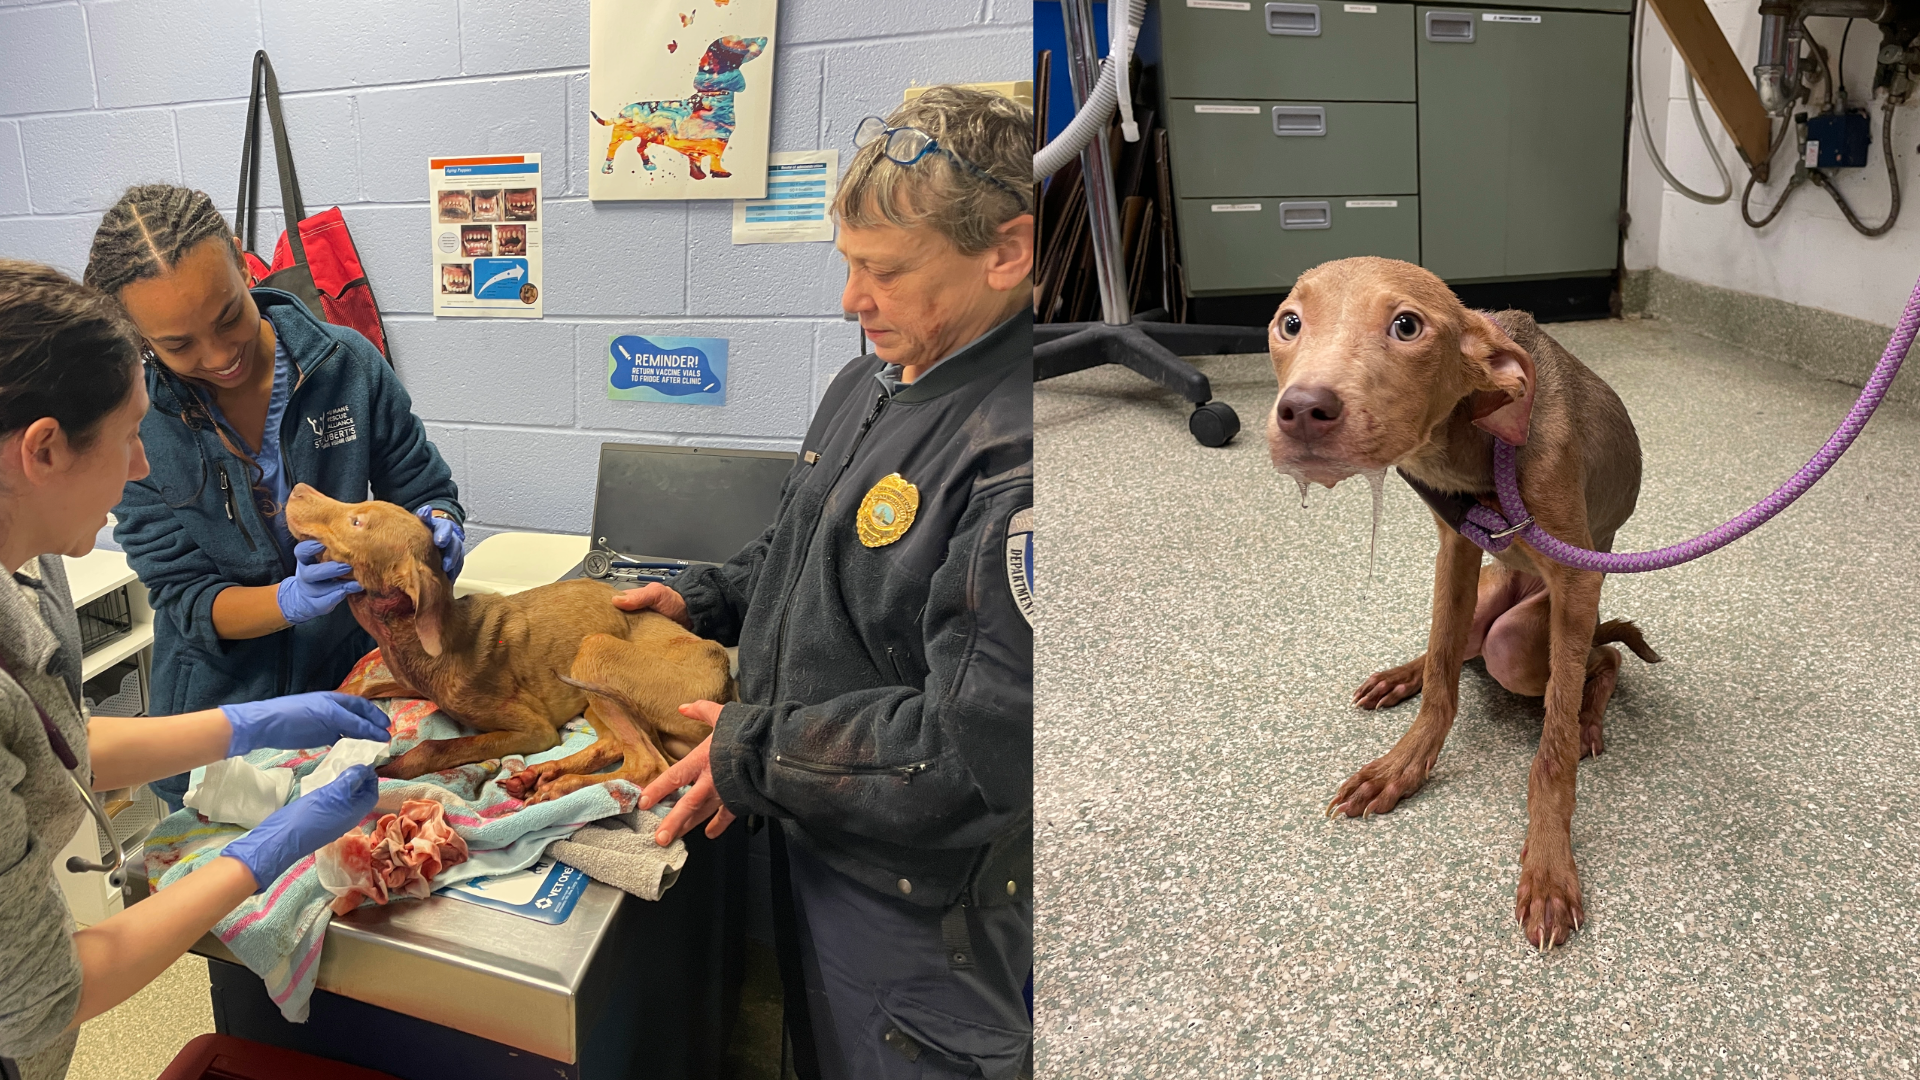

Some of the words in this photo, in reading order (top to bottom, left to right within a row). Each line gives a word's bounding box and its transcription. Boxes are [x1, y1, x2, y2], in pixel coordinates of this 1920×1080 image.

[635, 354, 698, 368] REMINDER!
[632, 367, 654, 375] RETURN
[656, 368, 681, 376] VACCINE
[682, 369, 701, 377] VIALS
[640, 375, 659, 383] FRIDGE
[661, 376, 680, 384] AFTER
[682, 377, 701, 385] CLINIC
[323, 427, 356, 443] UBERT'S
